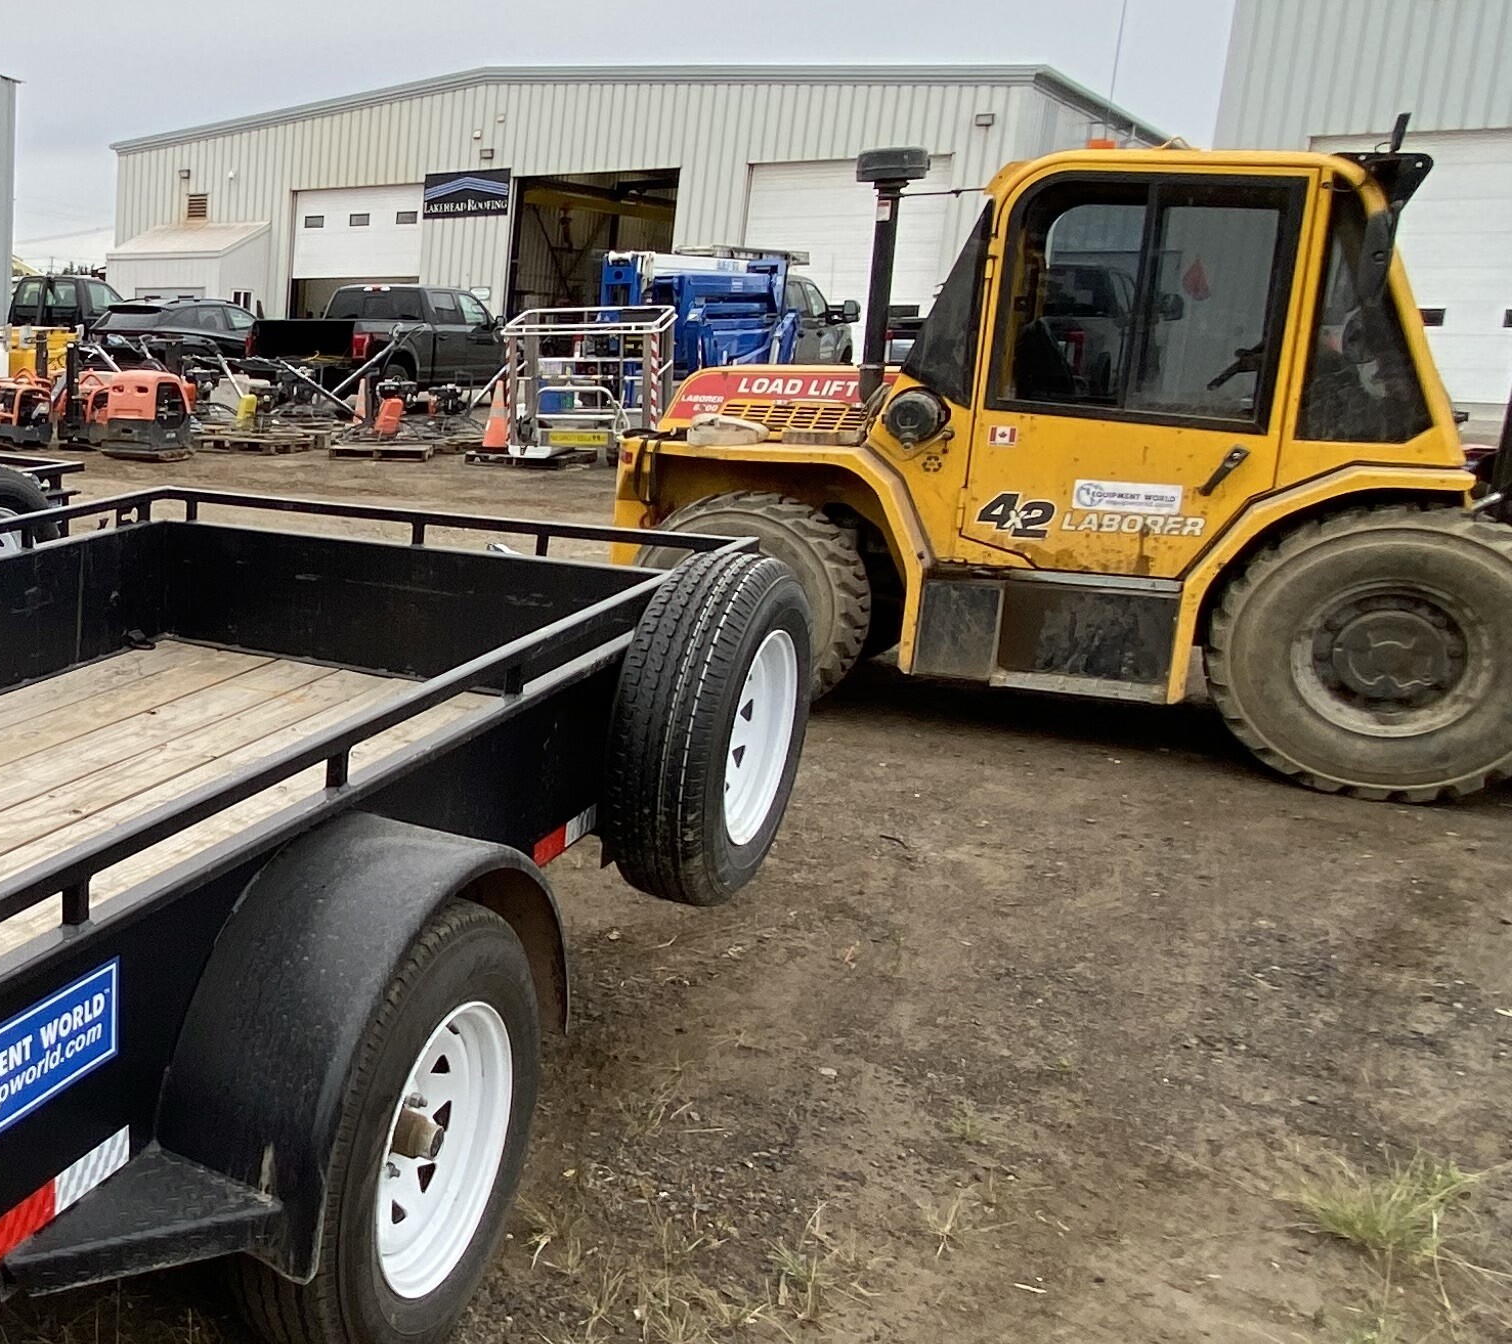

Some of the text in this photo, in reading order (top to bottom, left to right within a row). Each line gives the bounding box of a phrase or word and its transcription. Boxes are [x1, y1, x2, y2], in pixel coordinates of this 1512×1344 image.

[424, 199, 508, 214] LAKEHEAD ROOFING
[737, 377, 860, 397] LOAD LIFT
[681, 394, 725, 403] LABORER
[1061, 511, 1207, 537] LABORER
[40, 992, 106, 1049] WORLD
